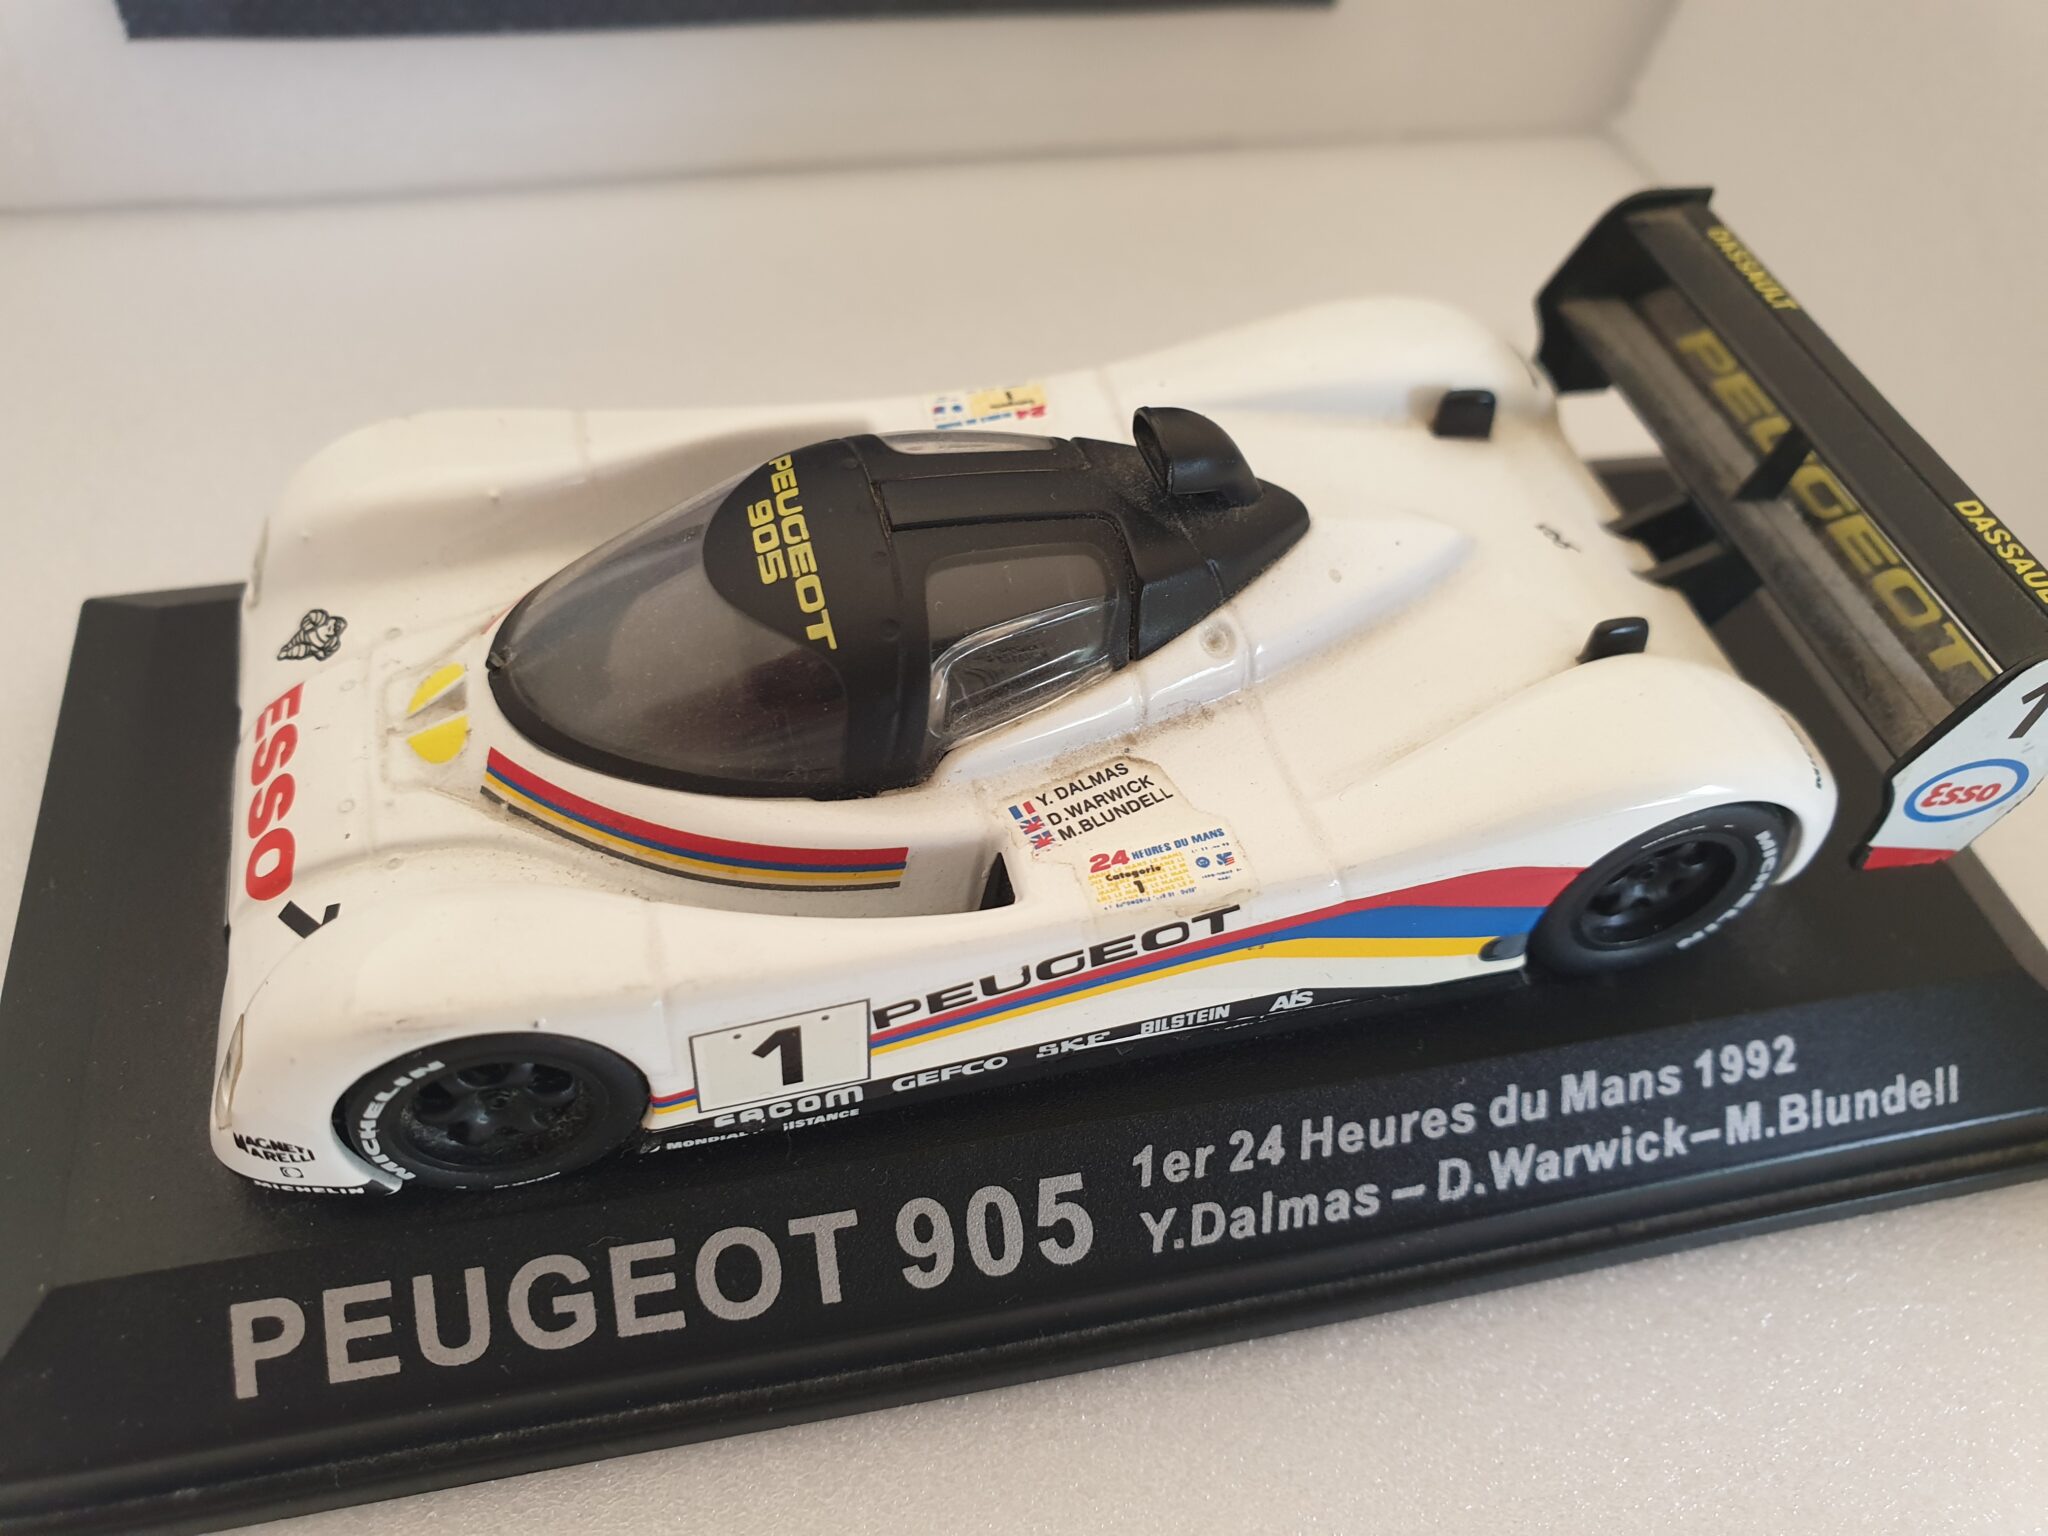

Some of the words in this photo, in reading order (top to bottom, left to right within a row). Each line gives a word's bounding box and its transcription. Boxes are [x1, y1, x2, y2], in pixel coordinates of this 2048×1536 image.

[747, 499, 788, 585] 905
[768, 453, 838, 650] PEUGEOT
[245, 681, 305, 901] ESSO
[1046, 775, 1155, 826] D.WARWICK
[1053, 763, 1130, 801] DALMAS
[1058, 788, 1174, 842] M.BLUNDELL
[1089, 849, 1130, 873] 24
[1131, 842, 1172, 860] HEURES
[1174, 838, 1189, 849] DU
[1191, 828, 1225, 844] MANS
[1133, 880, 1145, 894] 1
[872, 904, 1241, 1030] PEUGEOT
[1036, 1031, 1111, 1058] SKF
[1140, 1004, 1231, 1035] BILSTEIN
[752, 1025, 804, 1086] 1
[892, 1056, 1009, 1093] GEFCO
[359, 1060, 446, 1181] MICHELIN
[1132, 1142, 1215, 1188] 1er
[1229, 1123, 1286, 1172] 24
[1300, 1101, 1476, 1160] Heures
[1489, 1083, 1548, 1127] du
[1561, 1064, 1683, 1116] Mans
[1694, 1034, 1798, 1088] 1992
[666, 1131, 750, 1150] MONDIAL
[253, 1180, 365, 1194] MICHELIN
[1139, 1182, 1381, 1254] Y.Dalmas
[229, 1208, 859, 1400] PEUGEOT
[895, 1171, 1095, 1290] 905
